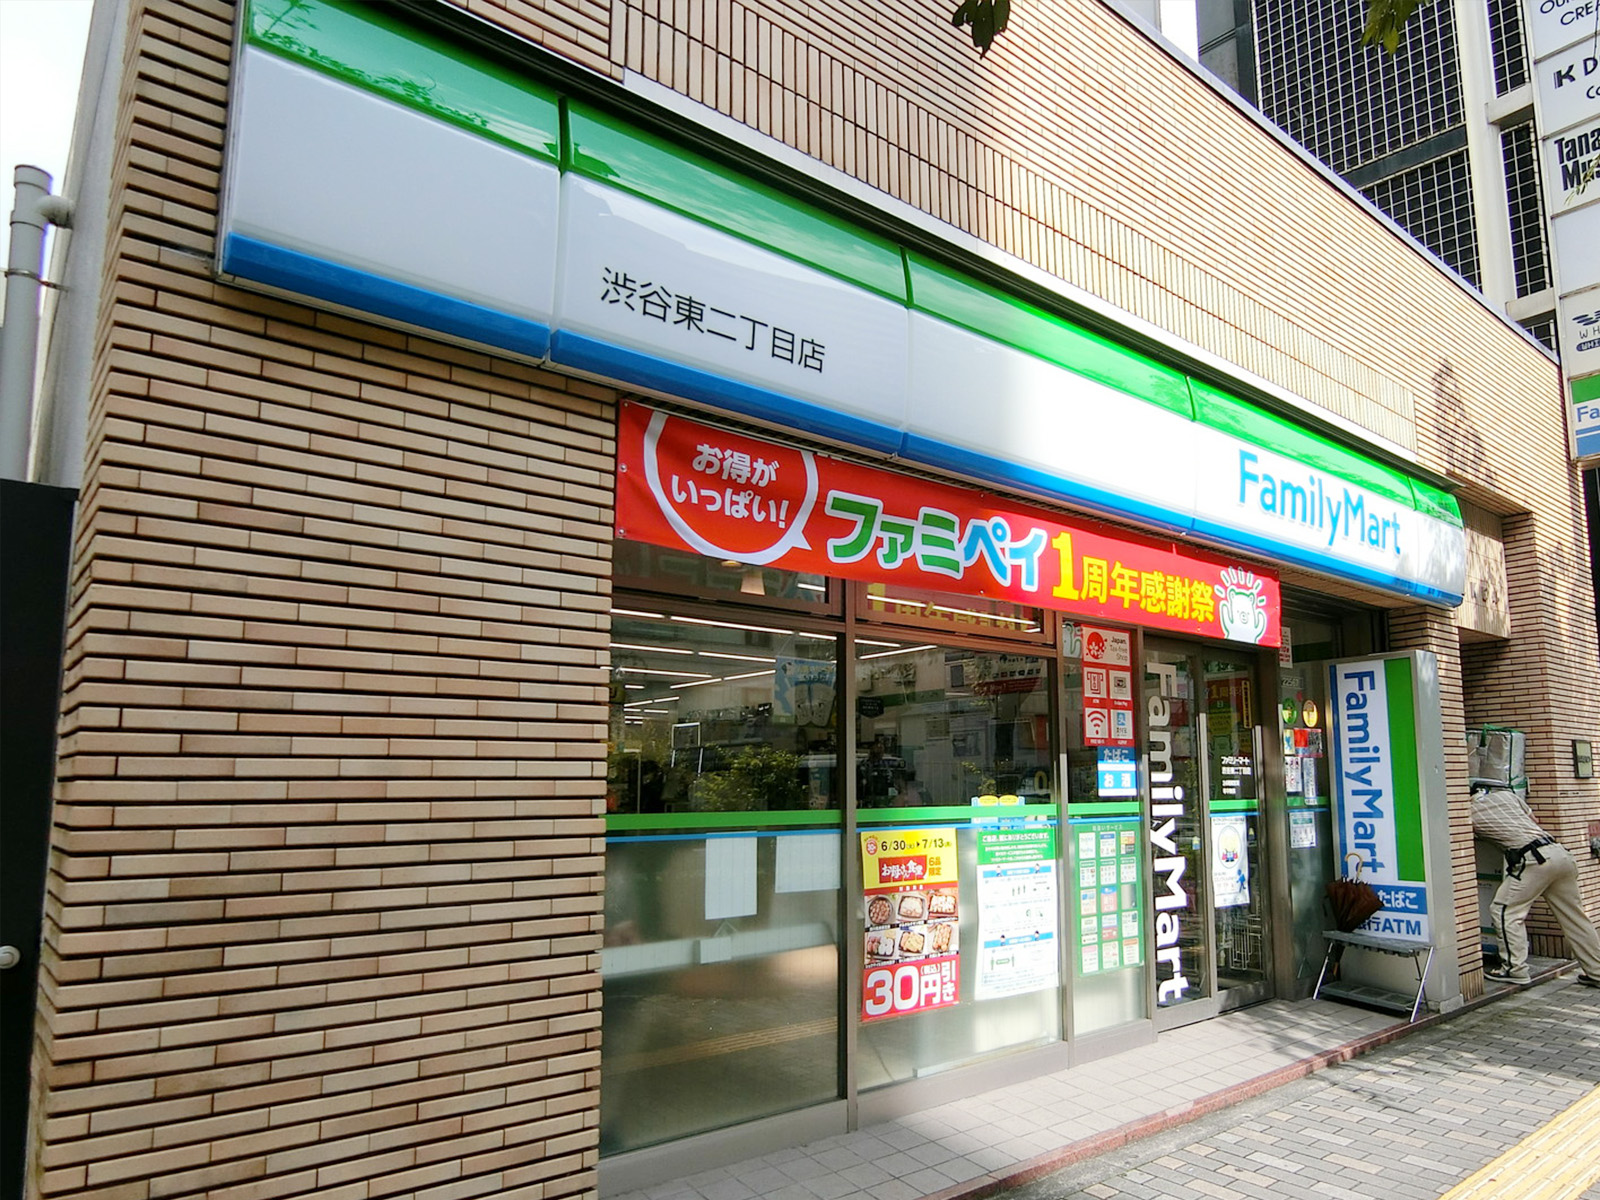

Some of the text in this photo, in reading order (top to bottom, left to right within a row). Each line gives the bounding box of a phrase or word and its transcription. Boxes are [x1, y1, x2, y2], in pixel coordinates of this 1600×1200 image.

[601, 267, 825, 373] 渋谷東二丁目店
[691, 443, 779, 487] お得が
[1239, 448, 1401, 555] FamilyMart
[1344, 670, 1385, 873] FamilyMart
[1147, 662, 1190, 1003] FamilyMart
[1377, 889, 1419, 909] たばこ
